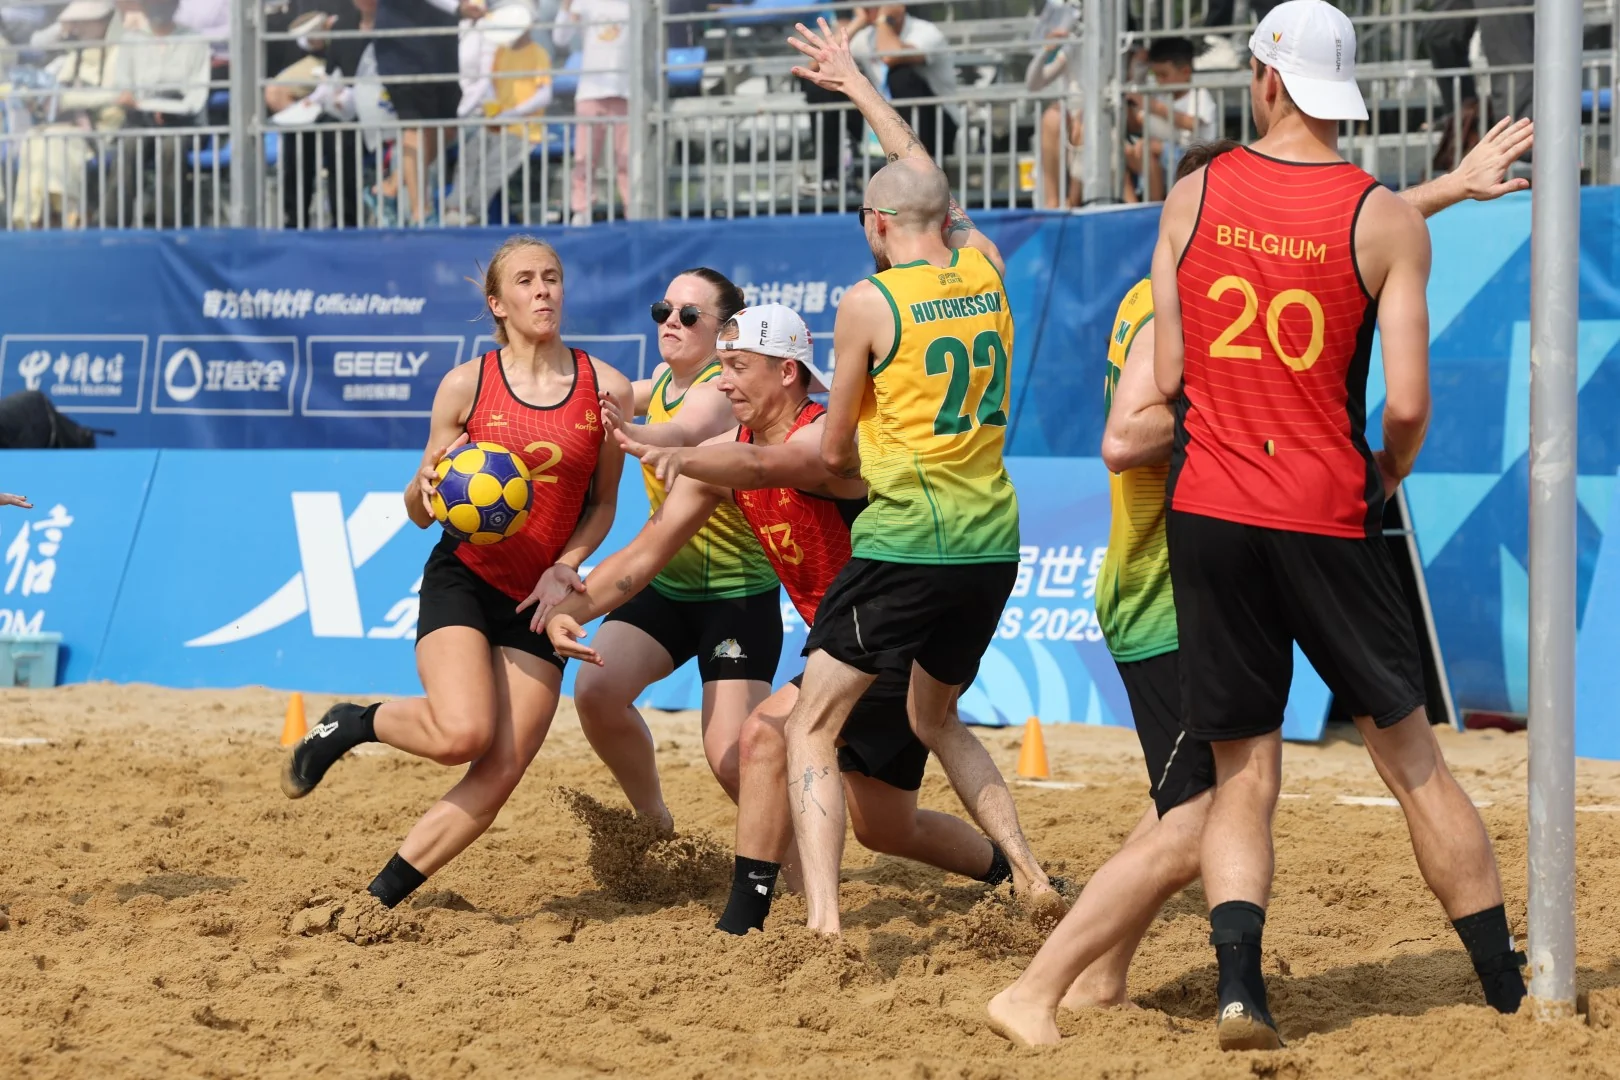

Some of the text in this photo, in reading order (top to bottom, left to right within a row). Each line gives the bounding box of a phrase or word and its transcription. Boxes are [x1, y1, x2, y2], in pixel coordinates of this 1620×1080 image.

[1216, 224, 1327, 264] BELGIUM
[314, 292, 370, 316] Official
[368, 293, 427, 315] Partner
[910, 290, 1002, 324] HUTCHESSON
[759, 320, 768, 346] BEL
[1206, 275, 1325, 372] 20
[333, 351, 428, 377] GEELY
[925, 330, 1008, 437] 22
[523, 441, 563, 484] 2
[760, 522, 804, 566] 13
[1024, 607, 1106, 642] 2025
